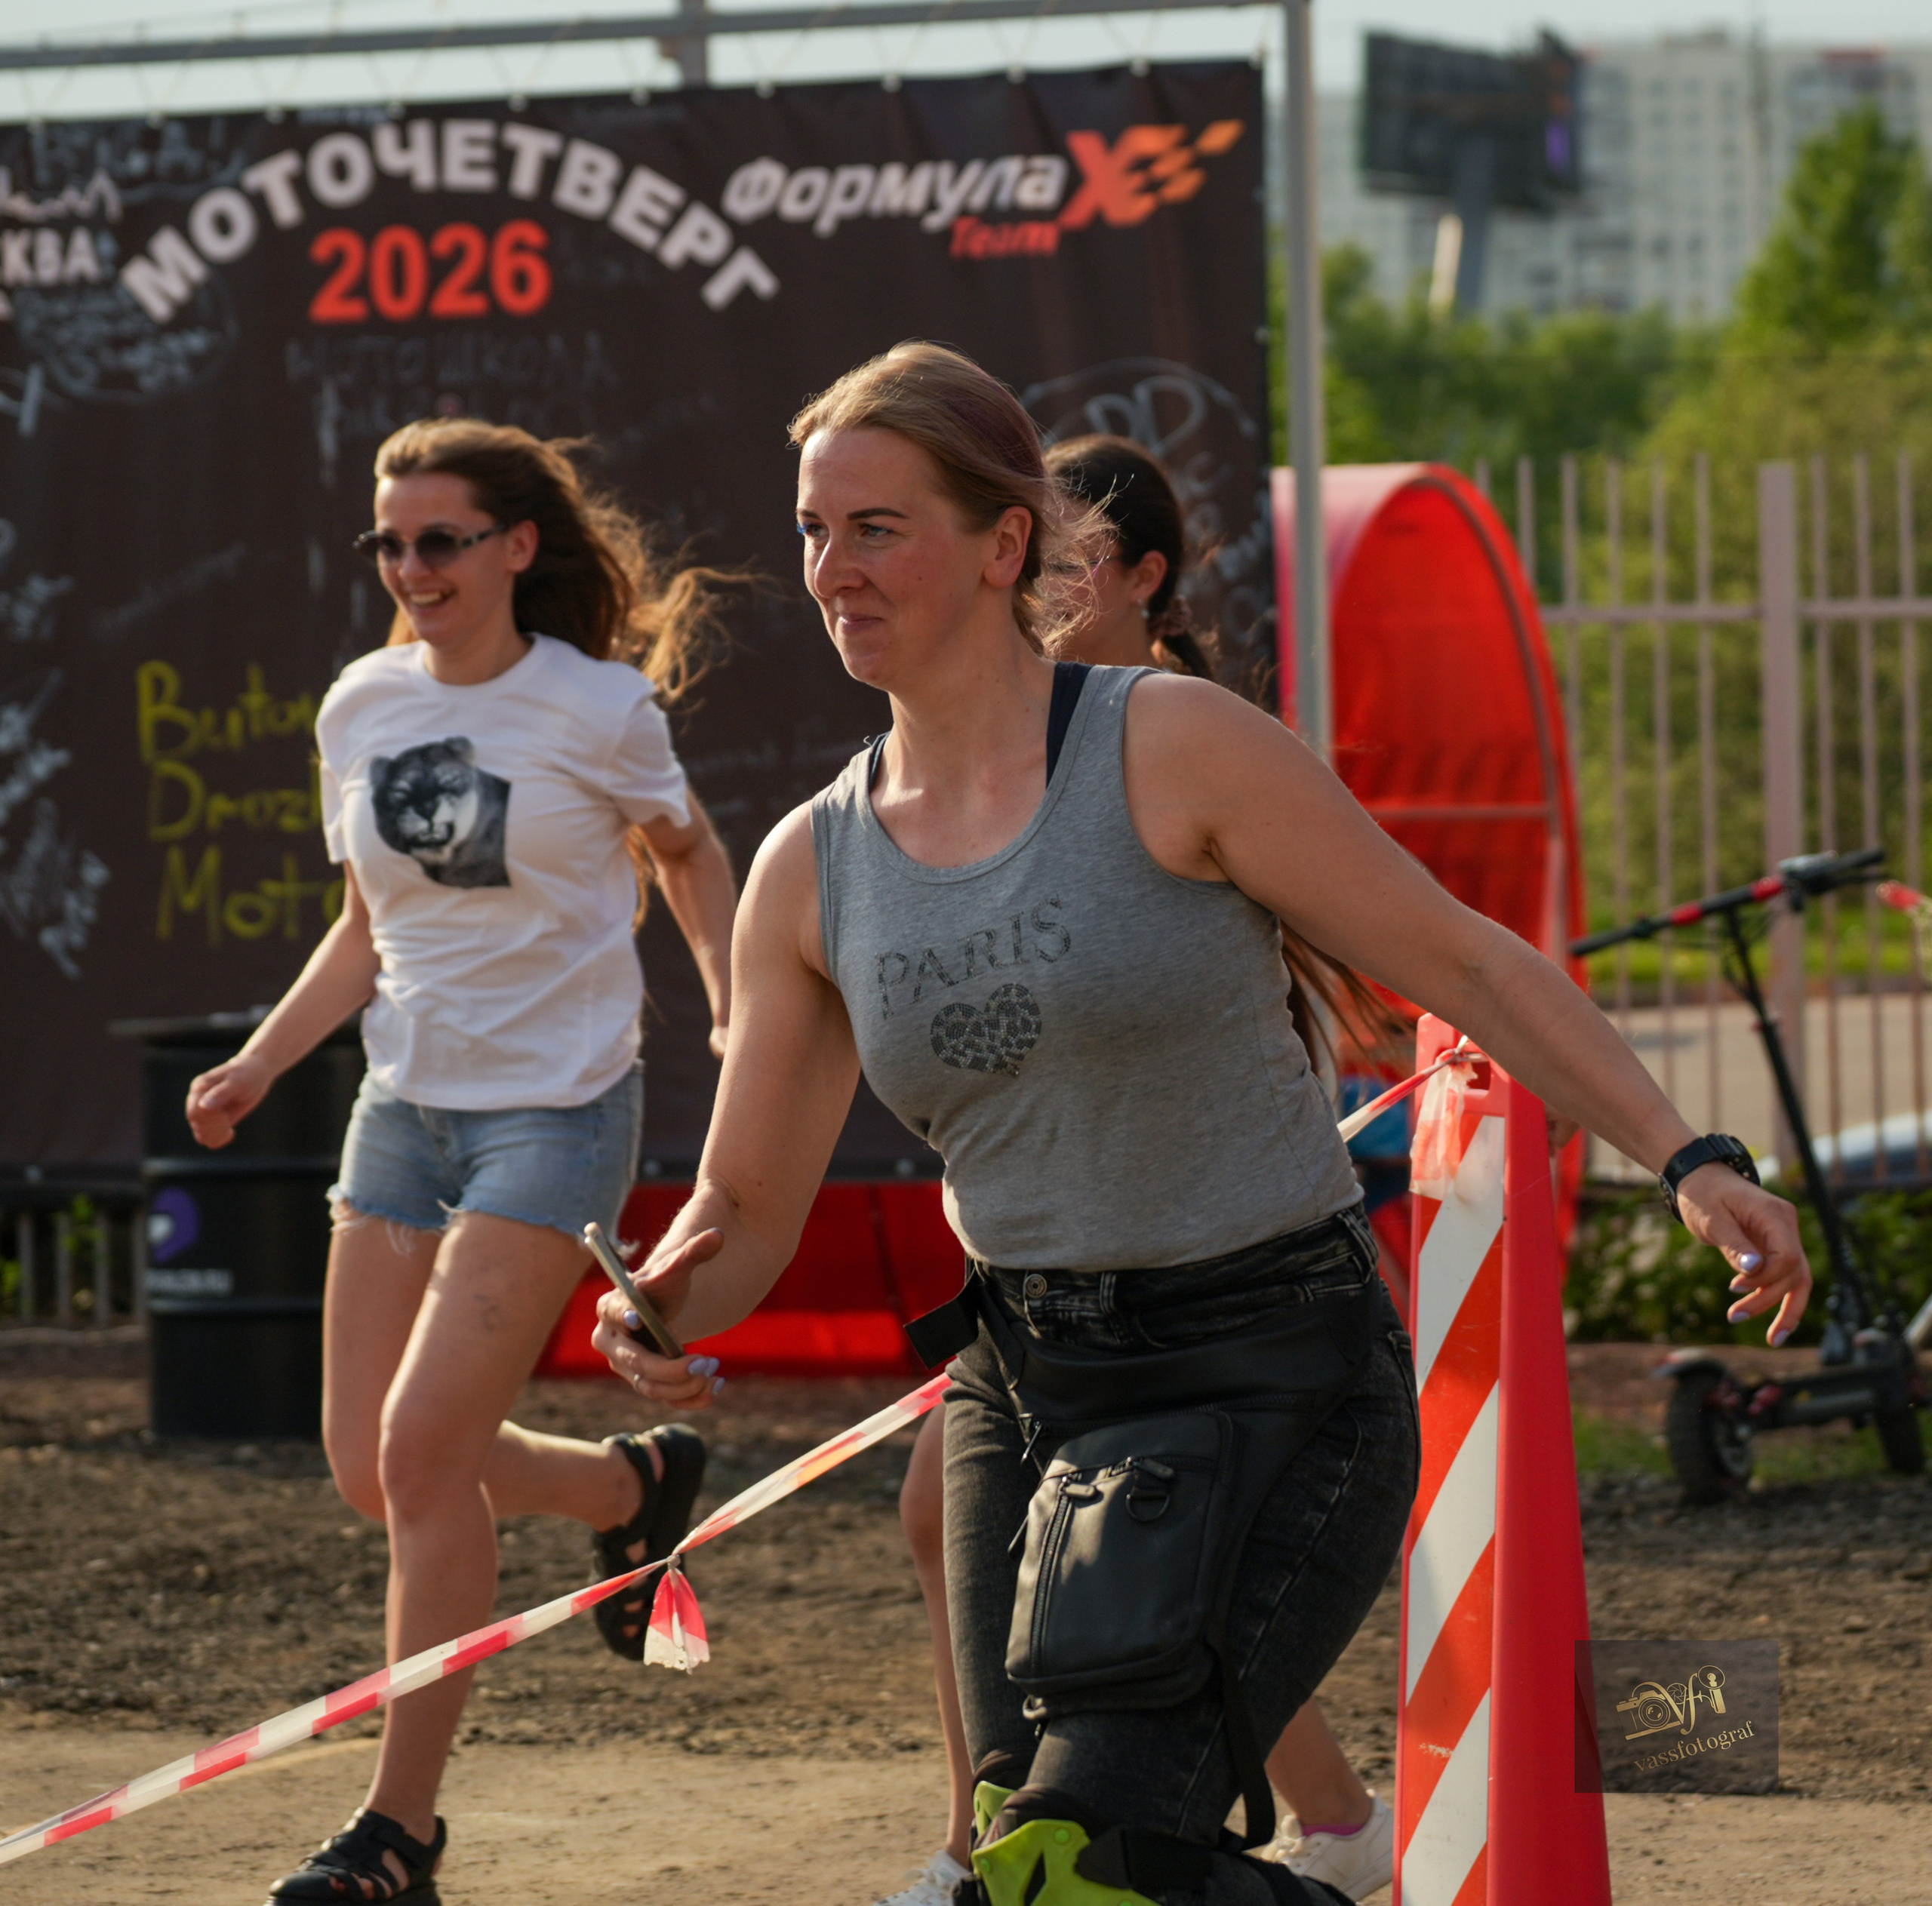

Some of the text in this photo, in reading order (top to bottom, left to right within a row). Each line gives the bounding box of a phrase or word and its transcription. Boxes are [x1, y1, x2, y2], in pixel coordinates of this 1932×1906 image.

[121, 118, 780, 324] МОТОЧЕТВЕРГ
[721, 153, 1069, 237] Формула
[950, 215, 1061, 261] Team
[309, 219, 553, 323] 2026
[874, 894, 1071, 1019] PARIS
